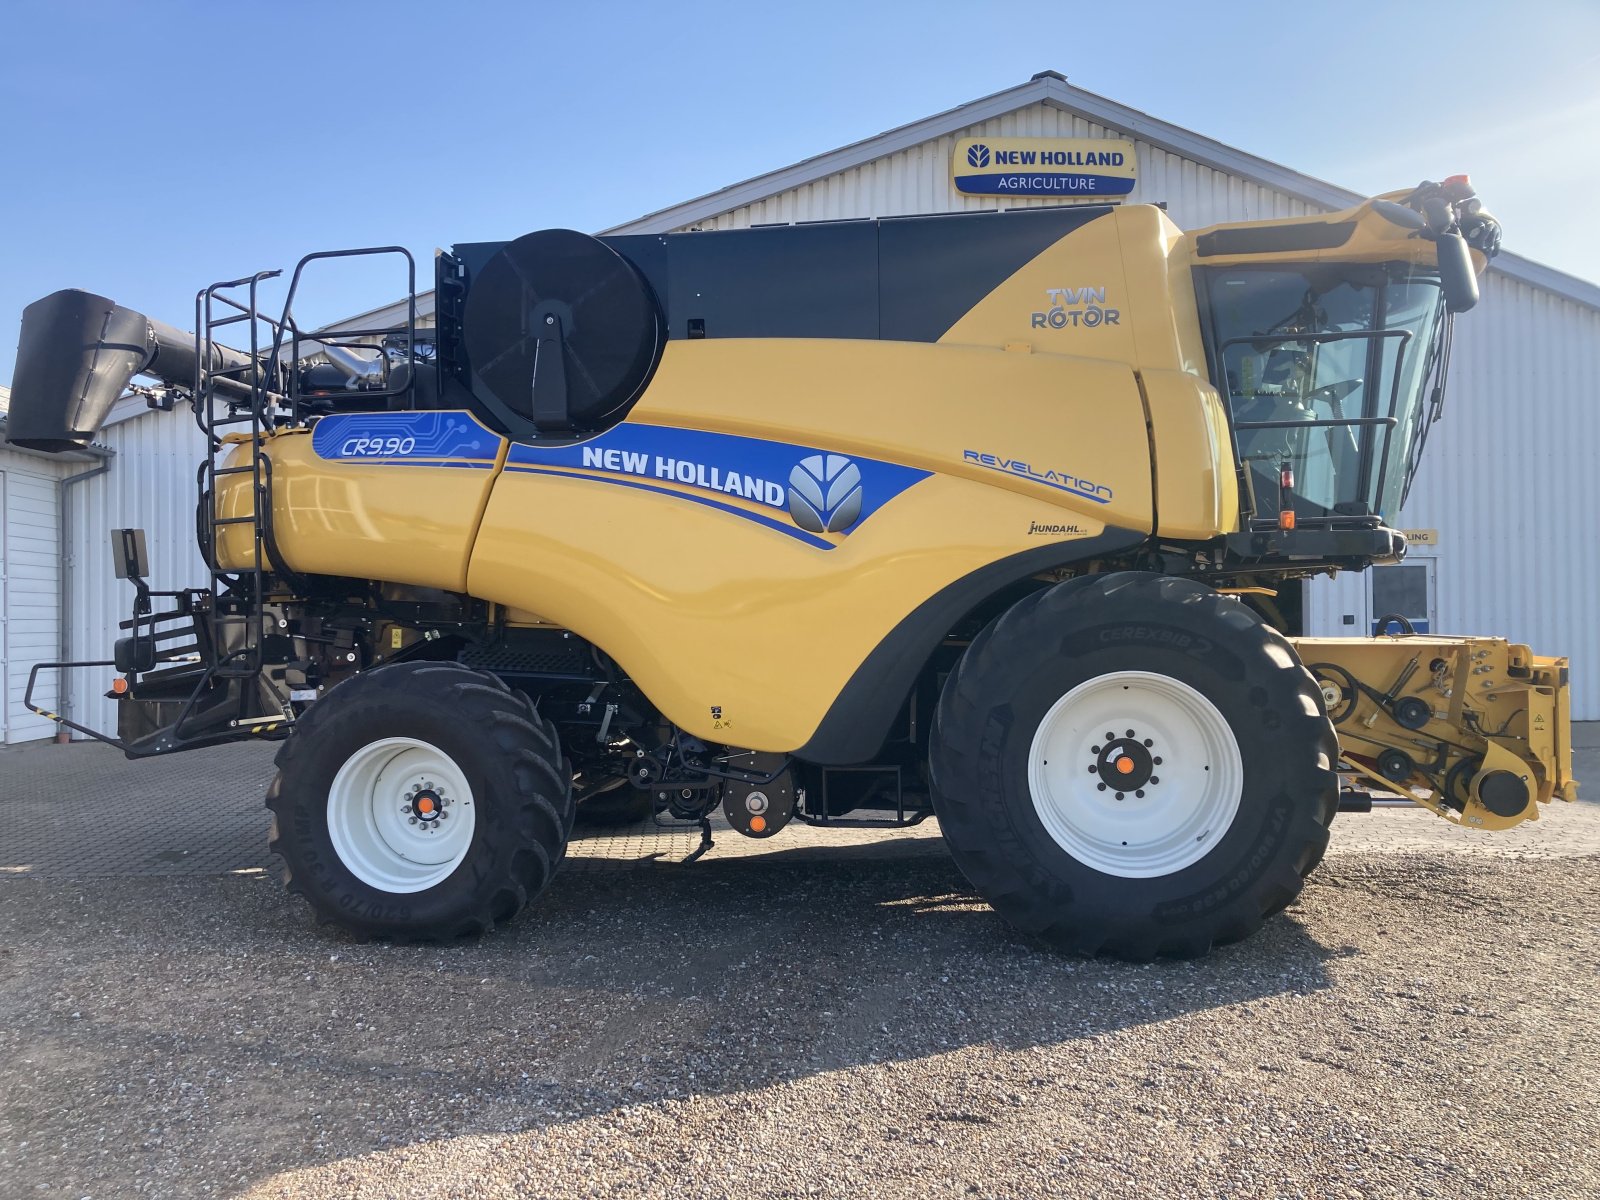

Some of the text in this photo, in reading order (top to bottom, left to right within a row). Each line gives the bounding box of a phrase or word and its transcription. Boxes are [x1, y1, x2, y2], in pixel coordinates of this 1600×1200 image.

[995, 151, 1123, 166] NEW HOLLAND
[998, 177, 1095, 190] AGRICULTURE
[1046, 286, 1105, 305] TWIN
[1031, 304, 1120, 329] ROTOR
[341, 437, 416, 456] CR9.90
[582, 446, 785, 507] NEW HOLLAND
[963, 449, 1113, 499] REVELATION
